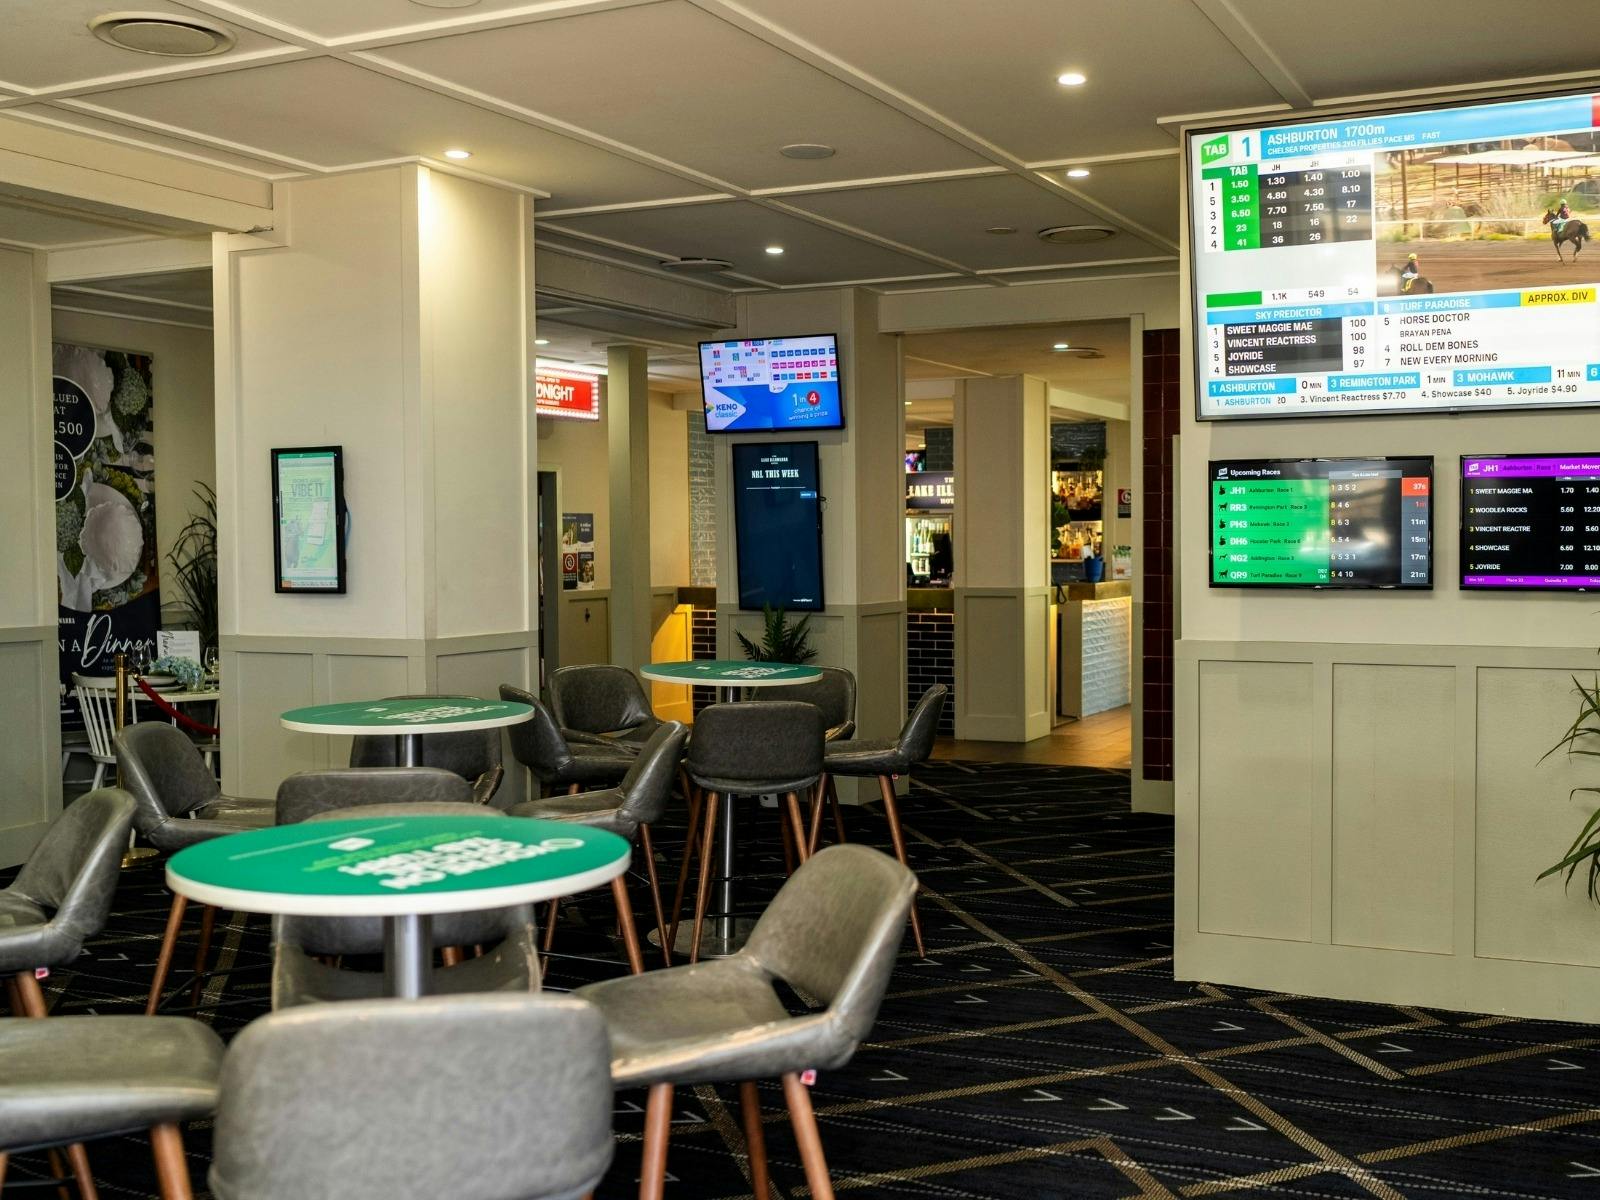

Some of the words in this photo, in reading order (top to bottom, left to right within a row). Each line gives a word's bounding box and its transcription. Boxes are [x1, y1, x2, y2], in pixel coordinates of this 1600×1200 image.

[1267, 128, 1338, 145] ASHBURTON
[1344, 125, 1385, 141] 1700m
[1242, 137, 1251, 158] 1
[1267, 146, 1299, 155] CHELSEA
[1300, 142, 1341, 152] PROPERTIES
[1357, 138, 1383, 147] FILLIES
[1422, 131, 1441, 140] FAST
[1203, 144, 1227, 156] TAB
[1230, 166, 1248, 176] TAB
[1272, 163, 1281, 171] JH
[1310, 160, 1320, 168] JH
[1267, 177, 1285, 185] 1.30
[1304, 173, 1323, 182] 1.40
[1341, 170, 1361, 179] 1.00
[1209, 197, 1216, 206] 5
[1231, 195, 1250, 203] 3.50
[1267, 191, 1287, 200] 4.80
[1304, 188, 1324, 197] 4.30
[1342, 184, 1361, 194] 8.10
[1210, 211, 1217, 220] 3
[1267, 206, 1287, 215] 7.70
[1304, 203, 1324, 211] 7.50
[1346, 200, 1356, 208] 17
[1210, 226, 1217, 235] 2
[1236, 224, 1247, 233] 23
[1272, 221, 1283, 230] 18
[1310, 218, 1320, 226] 16
[1346, 215, 1358, 224] 22
[1211, 240, 1217, 249] 4
[1236, 239, 1247, 247] 41
[1272, 236, 1284, 244] 36
[1309, 233, 1321, 242] 26
[1271, 293, 1287, 301] 1.1K
[1308, 290, 1325, 298] 549
[1527, 293, 1569, 303] APPROX.
[1571, 291, 1588, 301] DIV
[1400, 301, 1423, 311] TURF
[1424, 299, 1471, 310] PARADISE
[1255, 311, 1272, 319] SKY
[1274, 308, 1322, 318] PREDICTOR
[1384, 317, 1390, 326] 5
[1400, 315, 1430, 325] HORSE
[1432, 313, 1470, 323] DOCTOR
[1227, 326, 1256, 335] SWEET
[1258, 324, 1292, 333] MAGGIE
[1293, 322, 1313, 331] MAE
[1350, 319, 1366, 328] 100
[1400, 329, 1430, 338] BRAYAN
[1431, 328, 1452, 336] PENA
[1213, 341, 1219, 349] 3
[1227, 338, 1264, 348] VINCENT
[1266, 335, 1316, 345] REACTRESS
[1350, 333, 1367, 341] 100
[1384, 344, 1390, 353] 4
[1400, 343, 1423, 352] ROLL
[1425, 341, 1445, 351] DEM
[1447, 339, 1479, 349] BONES
[1214, 354, 1220, 362] 5
[1228, 351, 1264, 361] JOYRIDE
[1352, 346, 1364, 355] 98
[1384, 358, 1391, 367] 7
[1400, 356, 1421, 366] NEW
[1423, 355, 1452, 365] EVERY
[1454, 352, 1498, 363] MORNING
[1228, 364, 1277, 374] SHOWCASE
[1353, 360, 1365, 368] 97
[1456, 373, 1464, 383] 3
[1467, 371, 1515, 382] MOHAWK
[1557, 369, 1565, 378] 11
[1567, 370, 1581, 378] MIN
[1219, 382, 1275, 393] ASHBURTON
[1331, 379, 1337, 388] 3
[1339, 376, 1392, 388] REMINGTON
[1393, 376, 1417, 385] PARK
[1421, 390, 1429, 398] 4.
[1431, 389, 1472, 398] Showcase
[1474, 388, 1492, 396] $40
[1507, 387, 1515, 395] 5.
[1517, 385, 1550, 396] Joyride
[1551, 384, 1578, 394] $4.90
[792, 393, 798, 406] 1
[809, 392, 817, 403] 4
[1225, 397, 1271, 406] ASHBURTON
[1310, 394, 1339, 403] Vincent
[1341, 392, 1380, 402] Reactress
[1382, 391, 1406, 400] $7.70
[814, 411, 828, 419] prize
[751, 470, 764, 479] NRL
[765, 470, 780, 478] THIS
[781, 469, 799, 478] WEEK
[1230, 469, 1261, 477] Upcoming
[291, 483, 312, 497] VIBE
[909, 485, 934, 497] LAKE
[1230, 504, 1247, 512] RR3
[1230, 520, 1248, 528] PH3
[1230, 554, 1248, 562] NG2
[1230, 571, 1248, 580] QR9
[71, 640, 81, 652] A
[81, 614, 155, 668] Dinner
